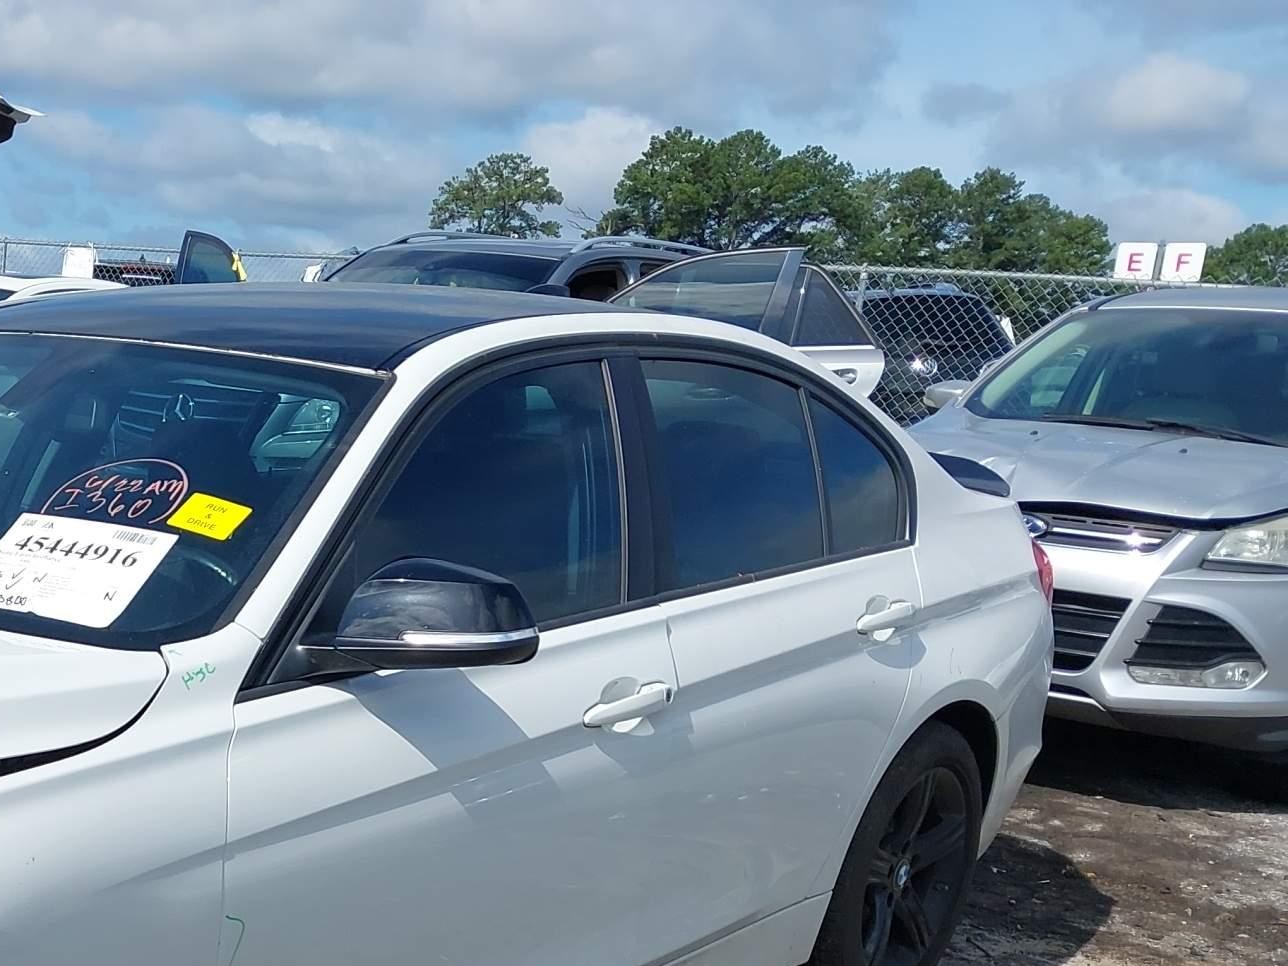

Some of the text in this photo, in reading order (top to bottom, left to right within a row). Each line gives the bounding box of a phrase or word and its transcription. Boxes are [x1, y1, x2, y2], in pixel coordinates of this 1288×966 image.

[1127, 252, 1144, 272] E
[1175, 253, 1193, 272] F
[205, 503, 228, 514] RUN
[186, 517, 217, 530] DRIVE
[14, 535, 143, 568] 45444916
